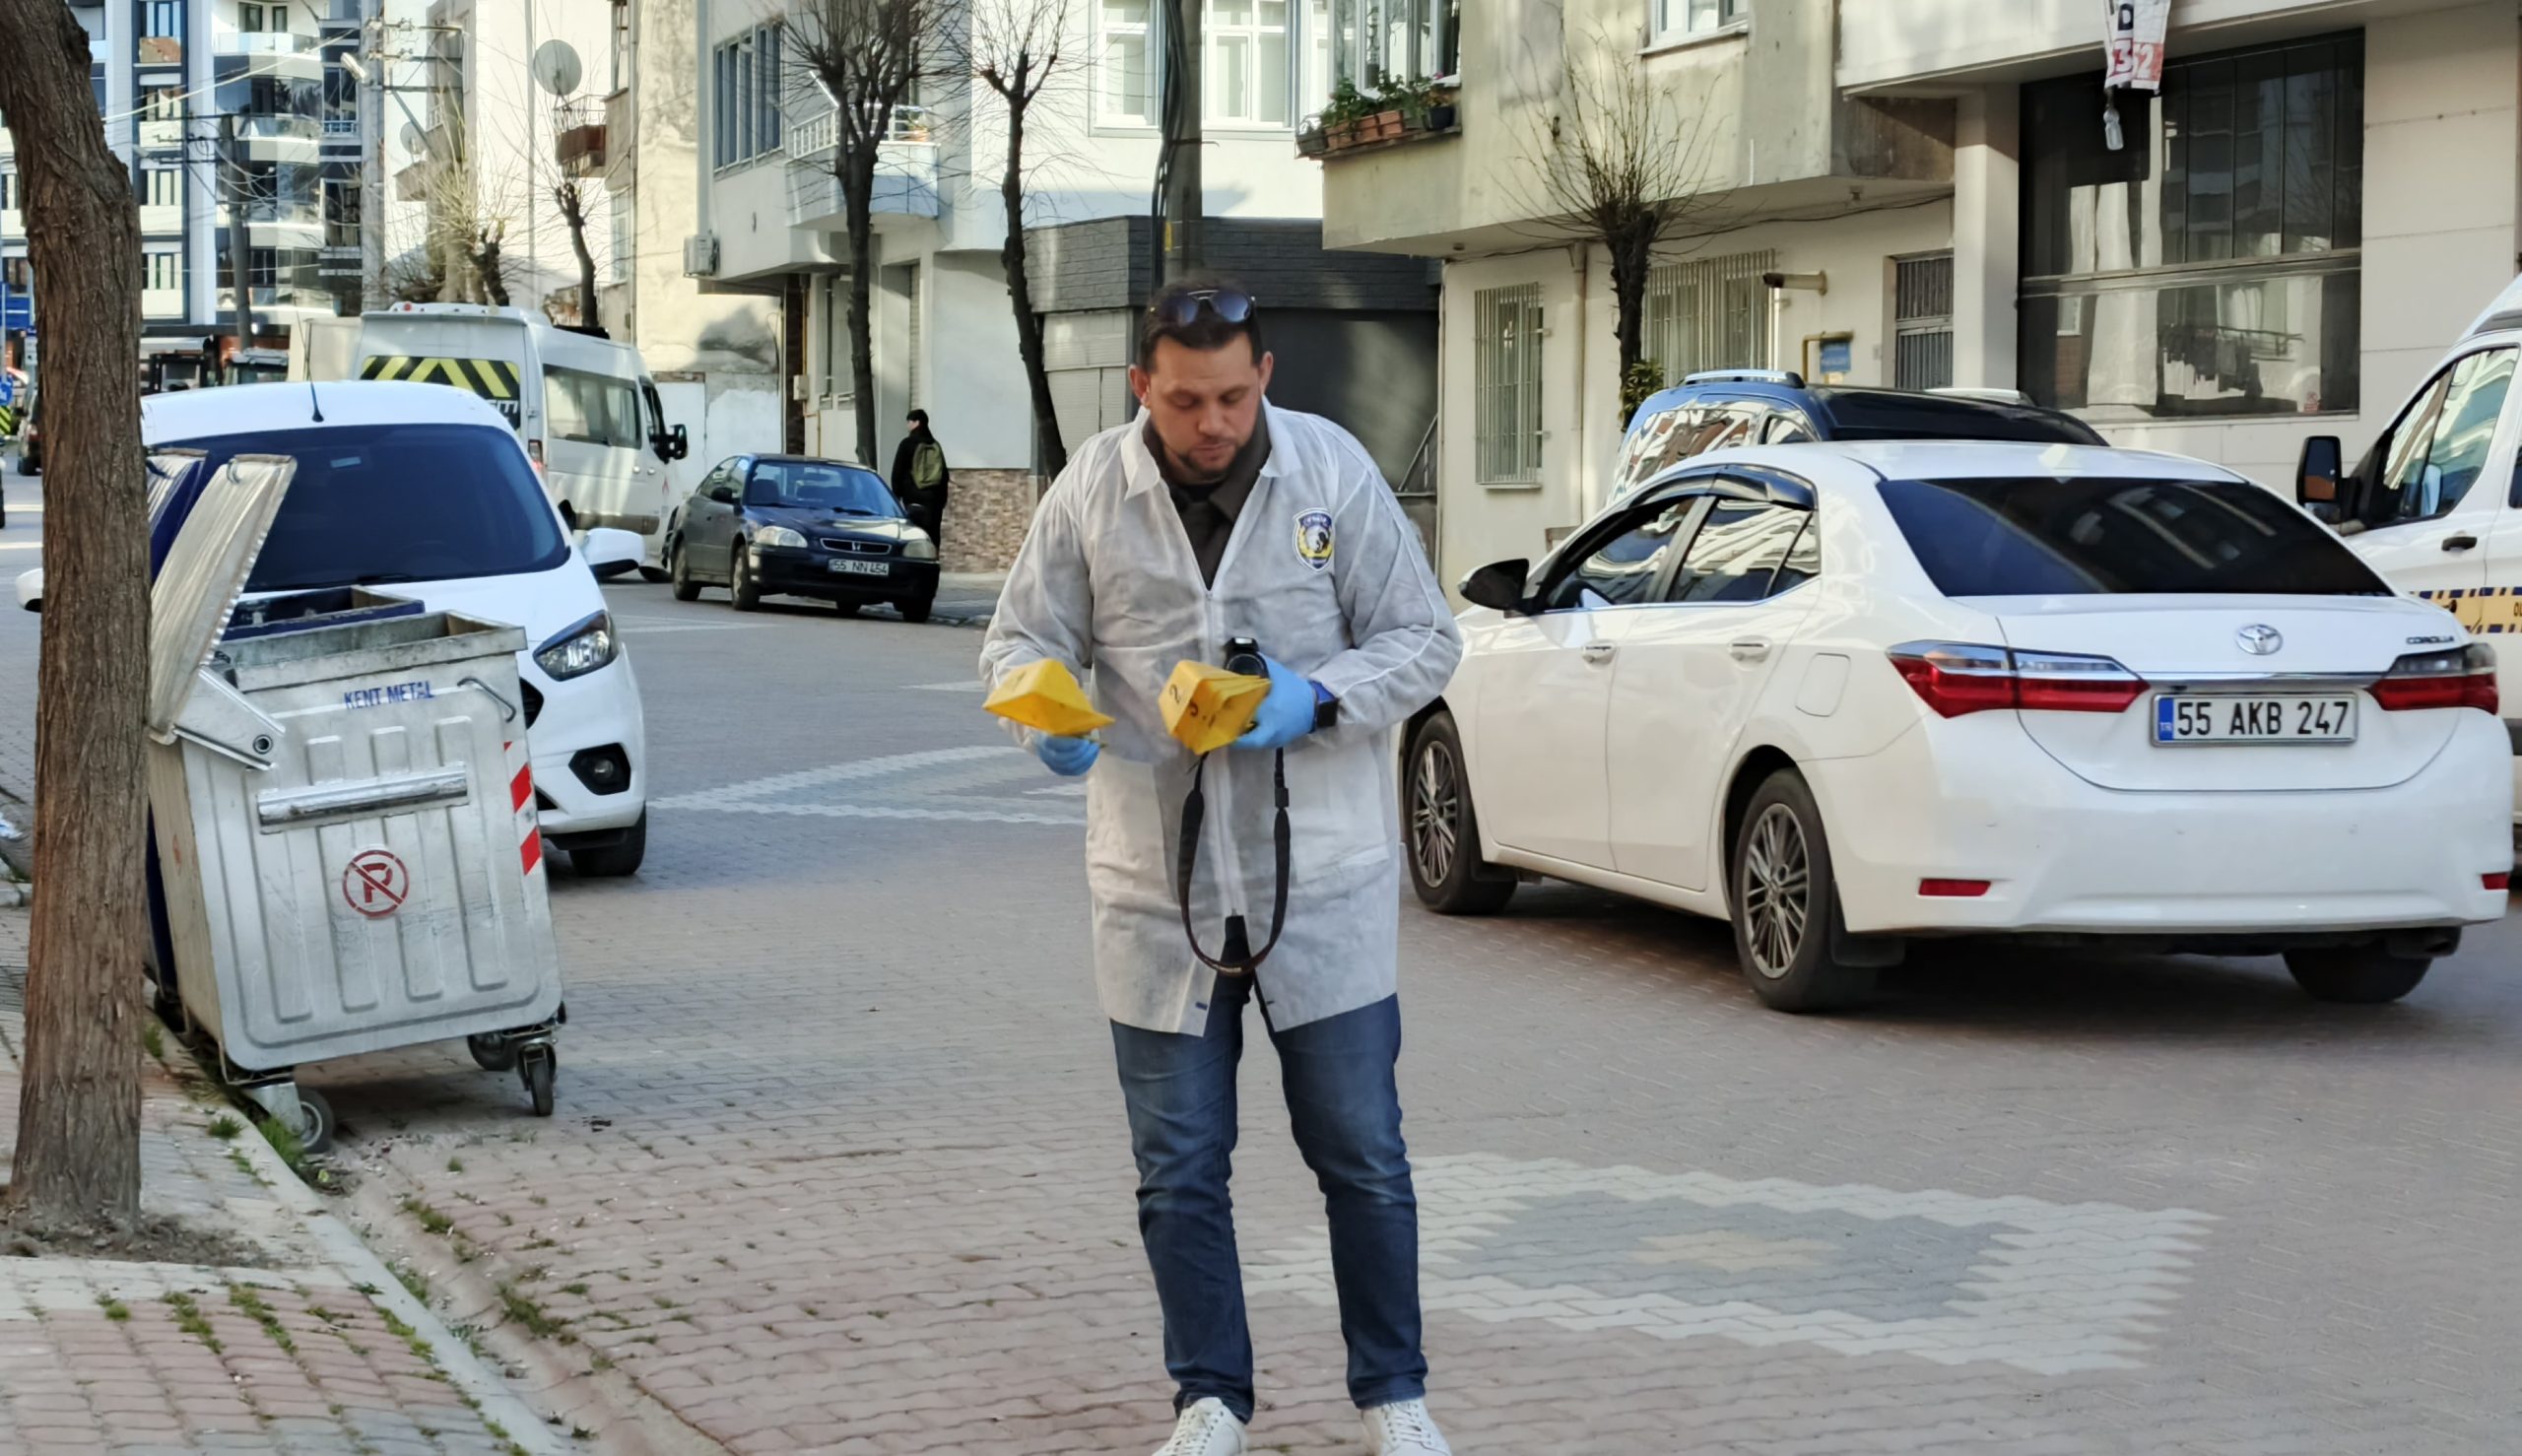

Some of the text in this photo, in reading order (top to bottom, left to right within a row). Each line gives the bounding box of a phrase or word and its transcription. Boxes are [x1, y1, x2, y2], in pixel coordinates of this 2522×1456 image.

[344, 681, 434, 709] KENT METAL
[2177, 701, 2212, 736] 55
[2228, 701, 2283, 735] AKB
[2296, 701, 2349, 735] 247
